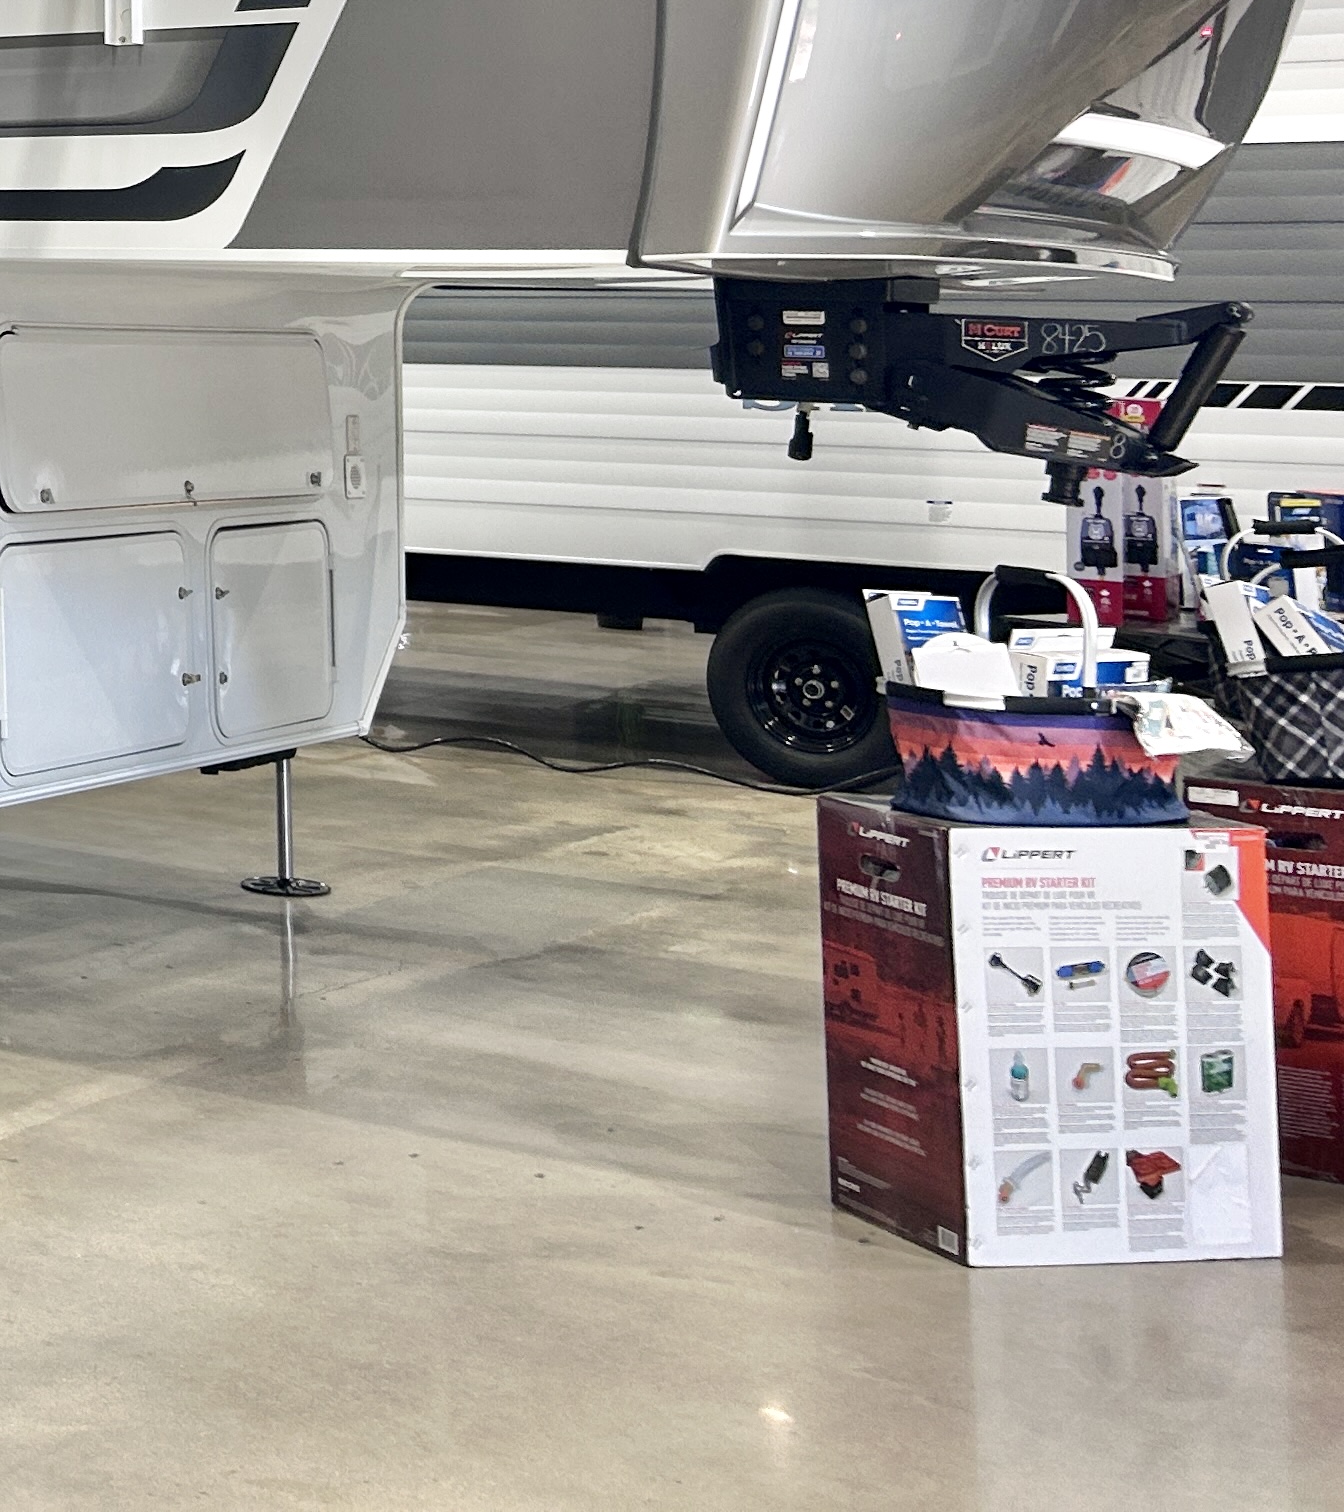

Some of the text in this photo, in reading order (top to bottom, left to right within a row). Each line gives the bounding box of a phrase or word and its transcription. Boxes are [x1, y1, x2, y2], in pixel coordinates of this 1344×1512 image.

[1040, 322, 1107, 355] 8425
[1261, 803, 1344, 820] LIPPERT
[1001, 849, 1078, 860] LIPPERT
[1039, 877, 1079, 889] STARTER
[1081, 877, 1096, 889] KIT
